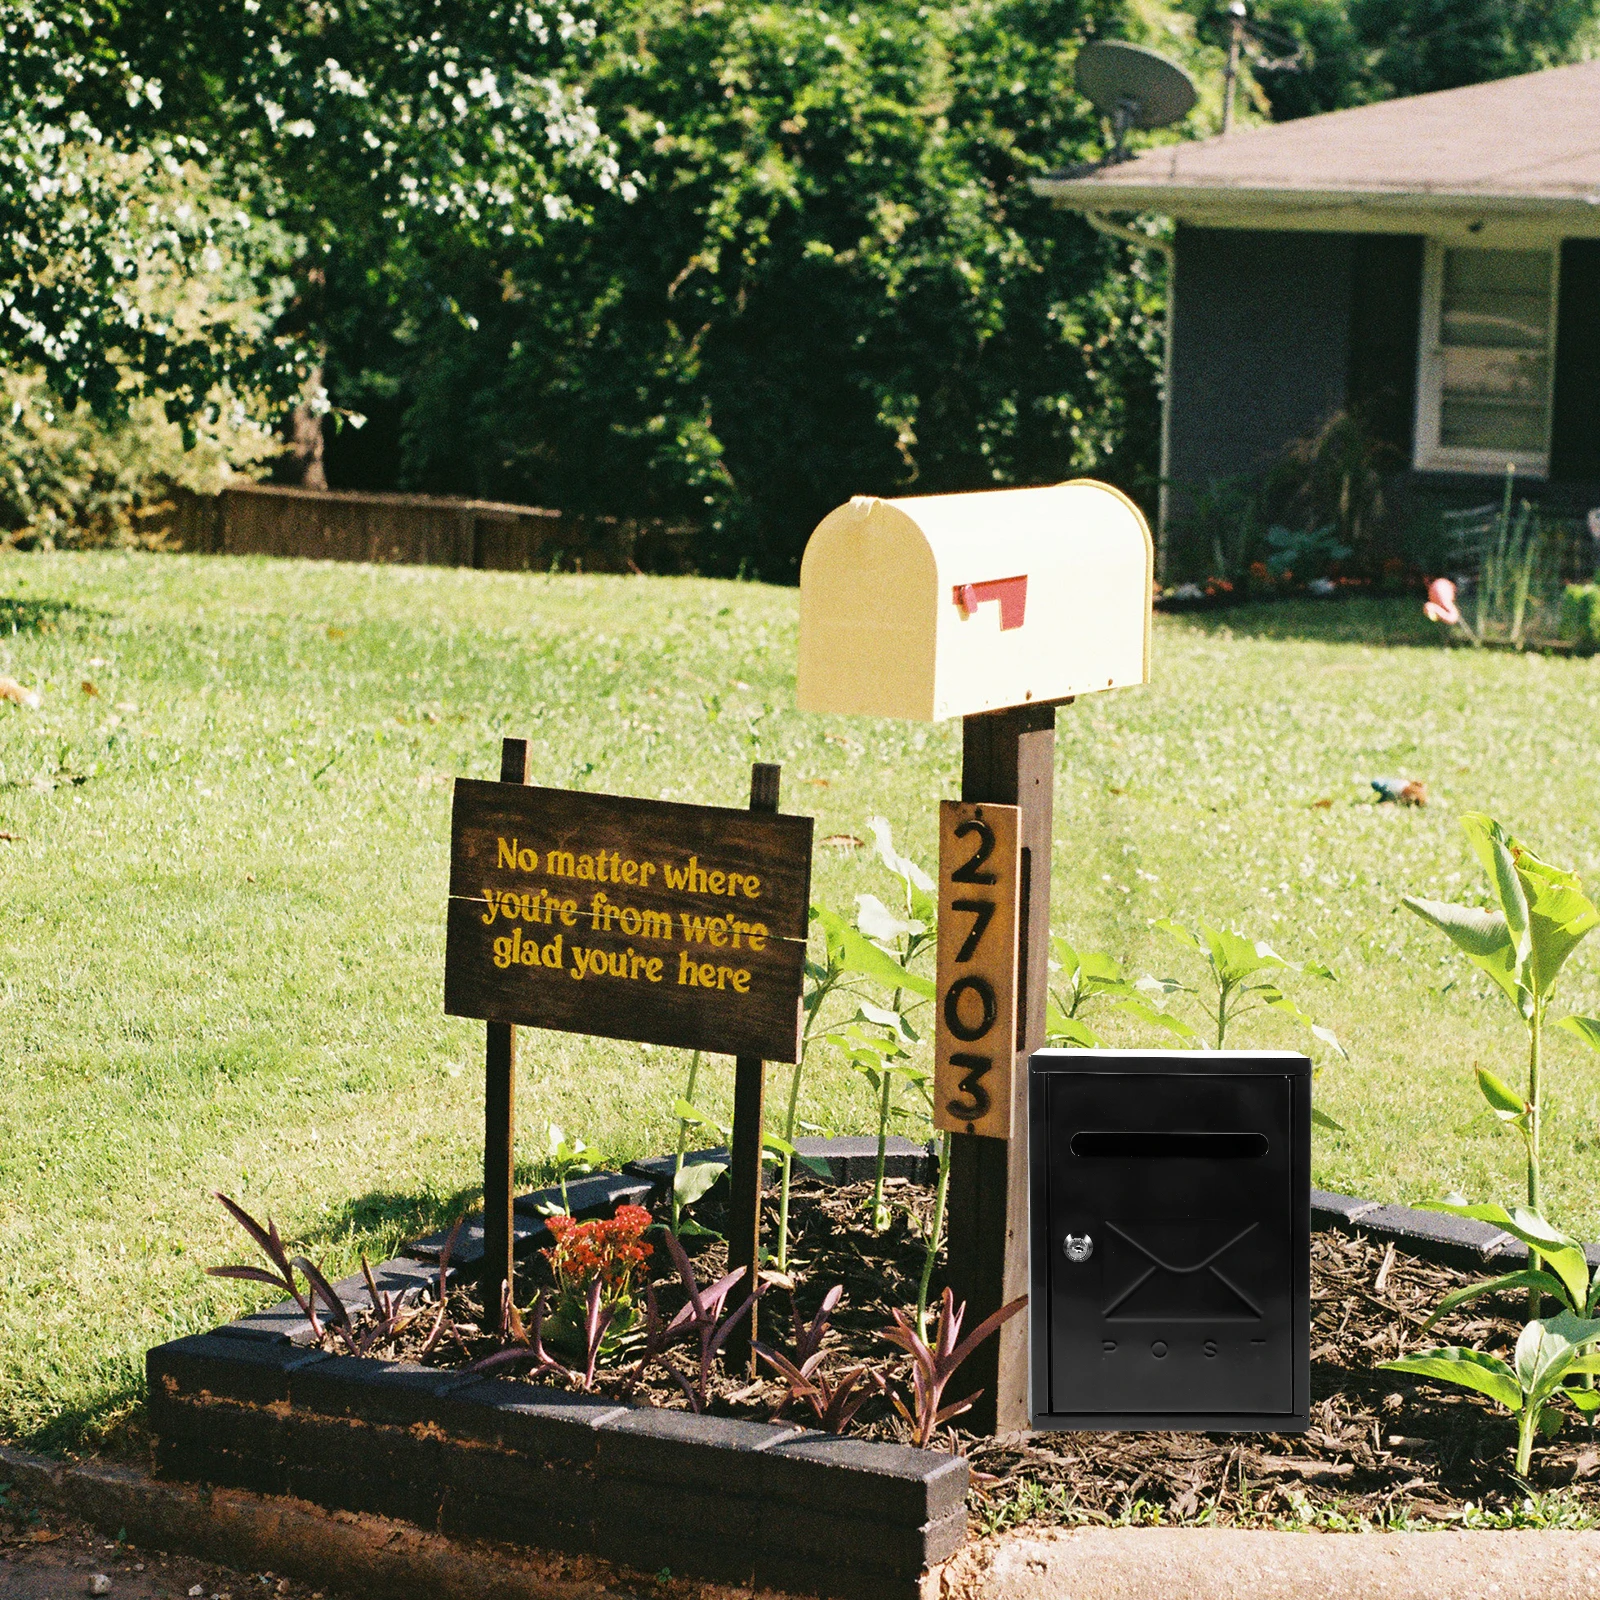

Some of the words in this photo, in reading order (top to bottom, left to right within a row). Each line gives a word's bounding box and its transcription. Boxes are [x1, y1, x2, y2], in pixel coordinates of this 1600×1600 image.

[497, 838, 539, 872] No
[546, 849, 656, 887] matter
[664, 856, 760, 898] where
[481, 888, 578, 925] you're
[590, 892, 673, 940] from
[679, 912, 769, 951] we're
[493, 927, 563, 969] glad
[571, 946, 663, 982] you're
[678, 951, 751, 993] here
[944, 820, 997, 1121] 2703
[1101, 1339, 1266, 1360] POST
